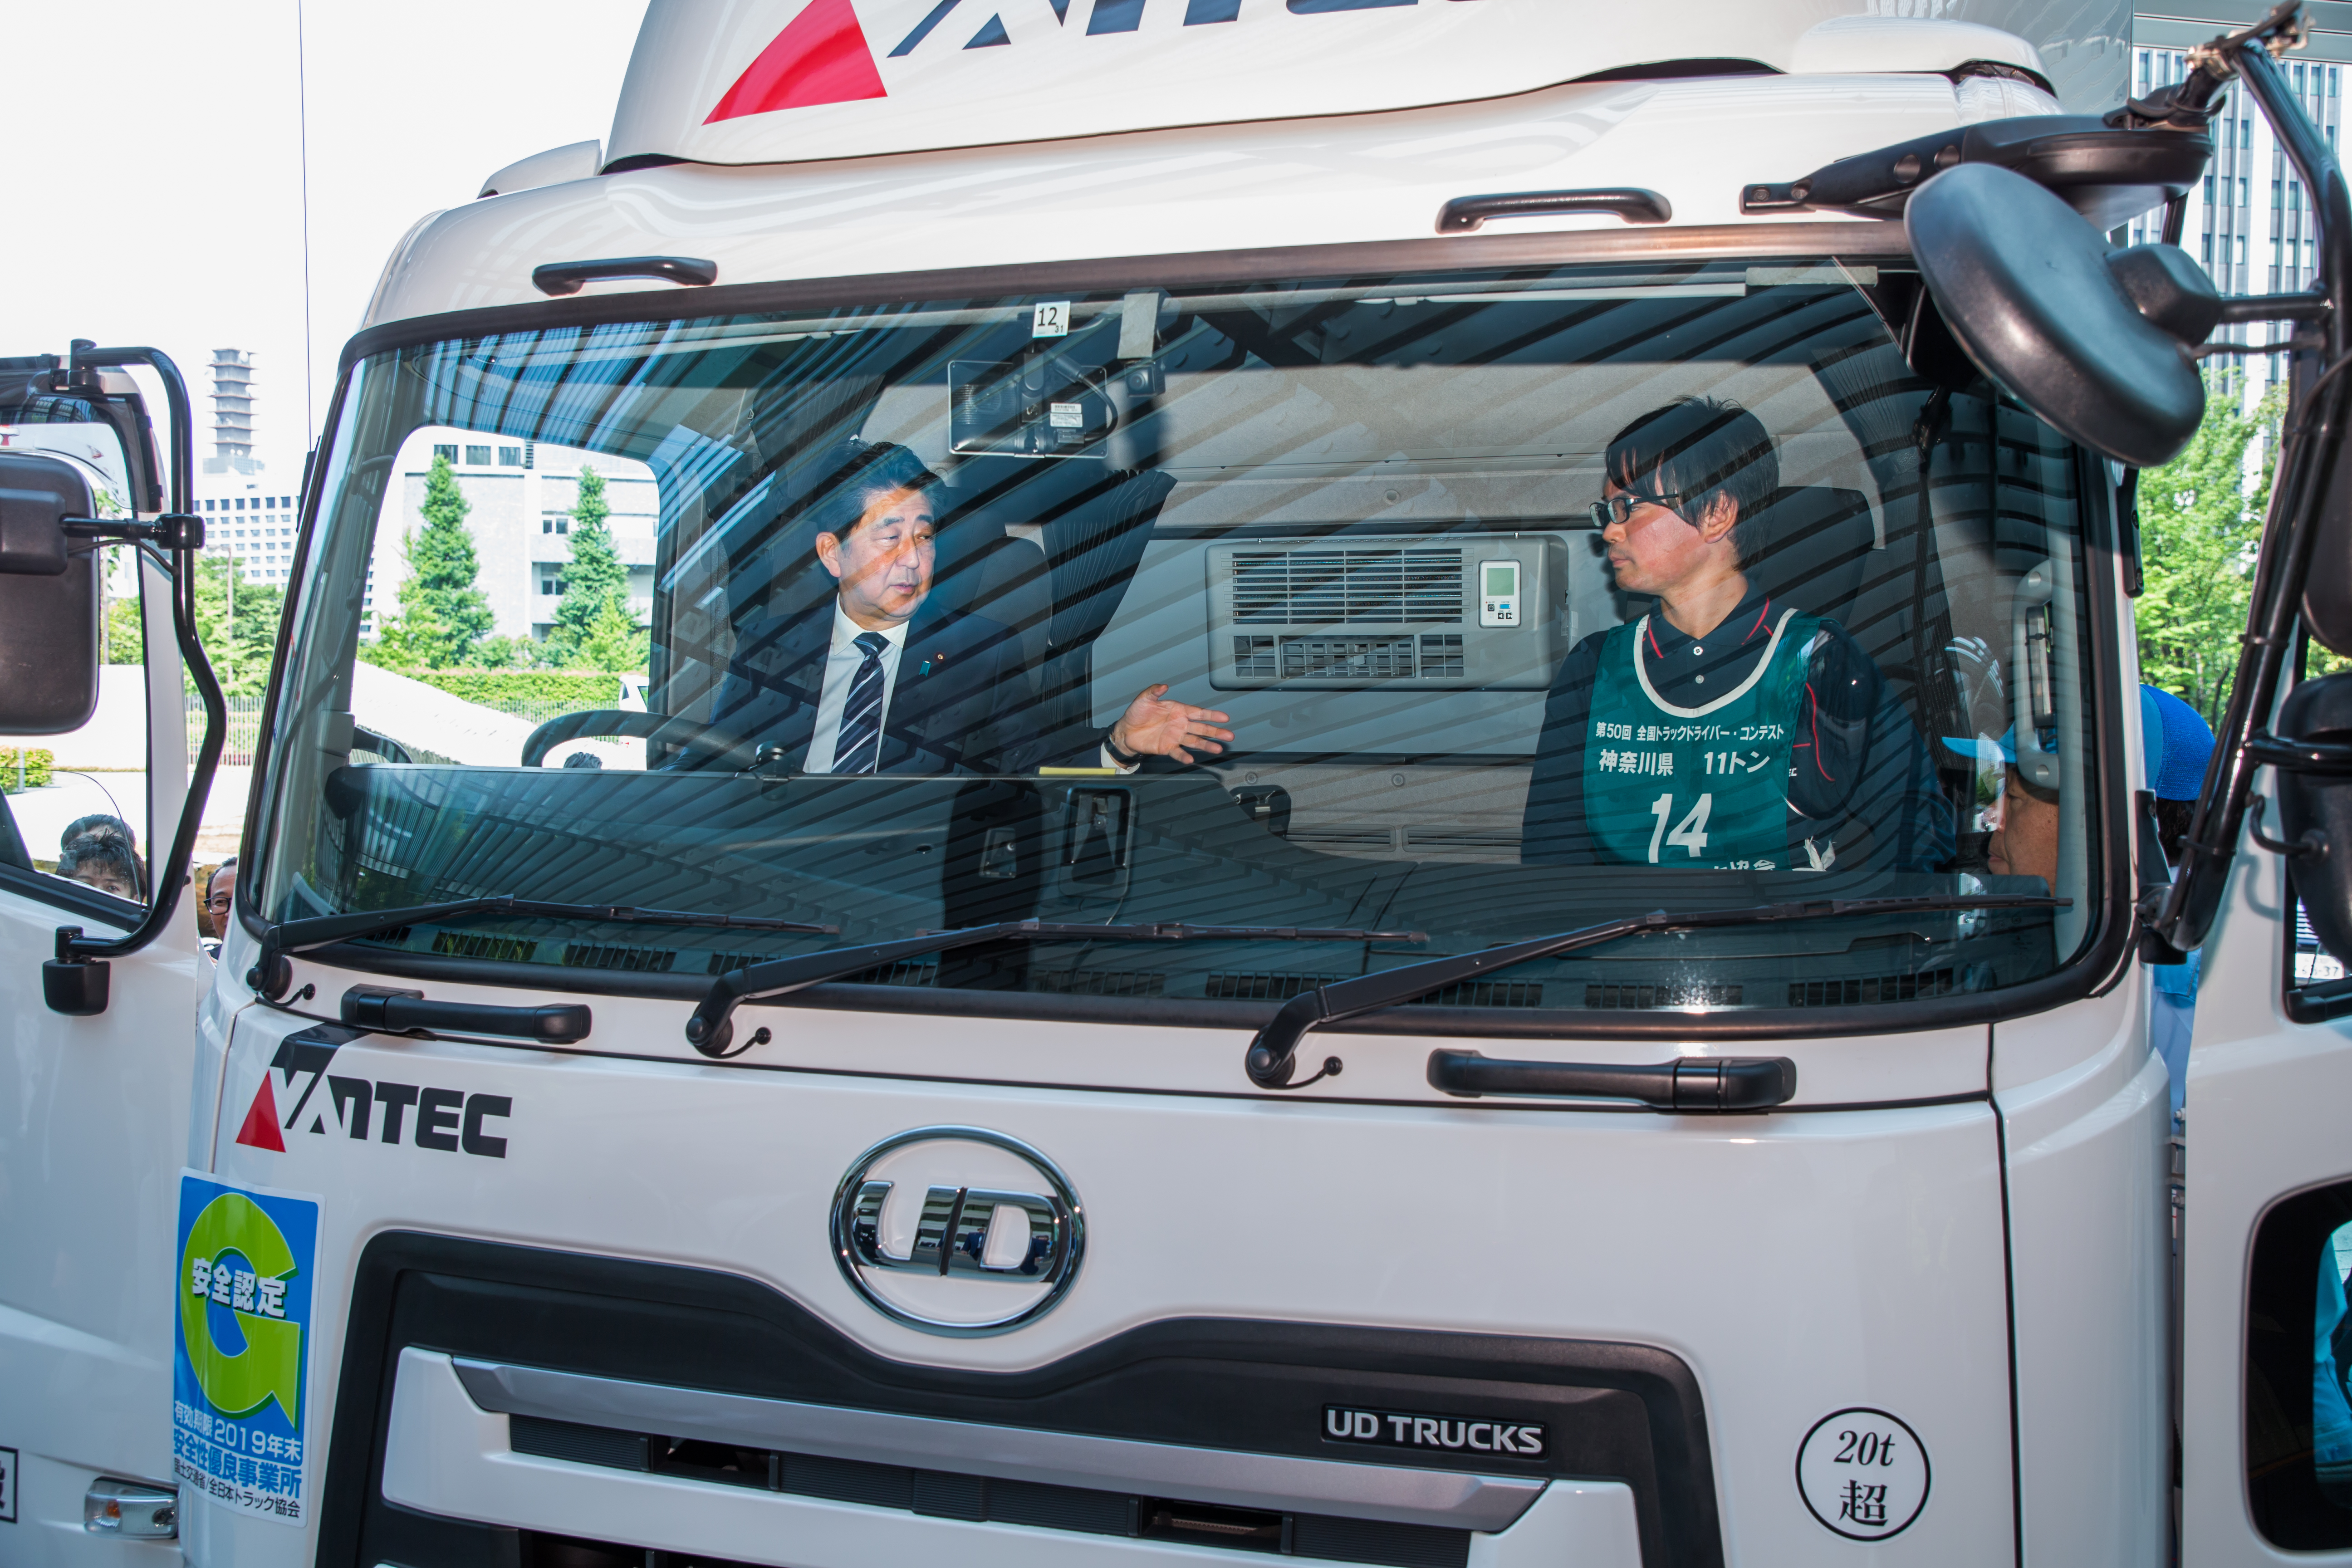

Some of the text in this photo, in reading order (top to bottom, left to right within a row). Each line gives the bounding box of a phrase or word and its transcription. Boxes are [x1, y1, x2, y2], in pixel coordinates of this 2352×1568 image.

[1037, 307, 1058, 327] 12
[1055, 325, 1063, 333] 31
[1595, 721, 1784, 742] 第50回 全国トラックドライバー・コンテスト
[1599, 749, 1770, 776] 神奈川県 11トン
[1648, 793, 1712, 863] 14
[852, 1181, 1057, 1283] UD
[191, 1257, 287, 1318] 安全認定
[1327, 1409, 1542, 1454] UD TRUCKS
[1833, 1430, 1896, 1466] 20t
[173, 1427, 302, 1499] 安全性優良事業所
[1838, 1479, 1888, 1527] 超
